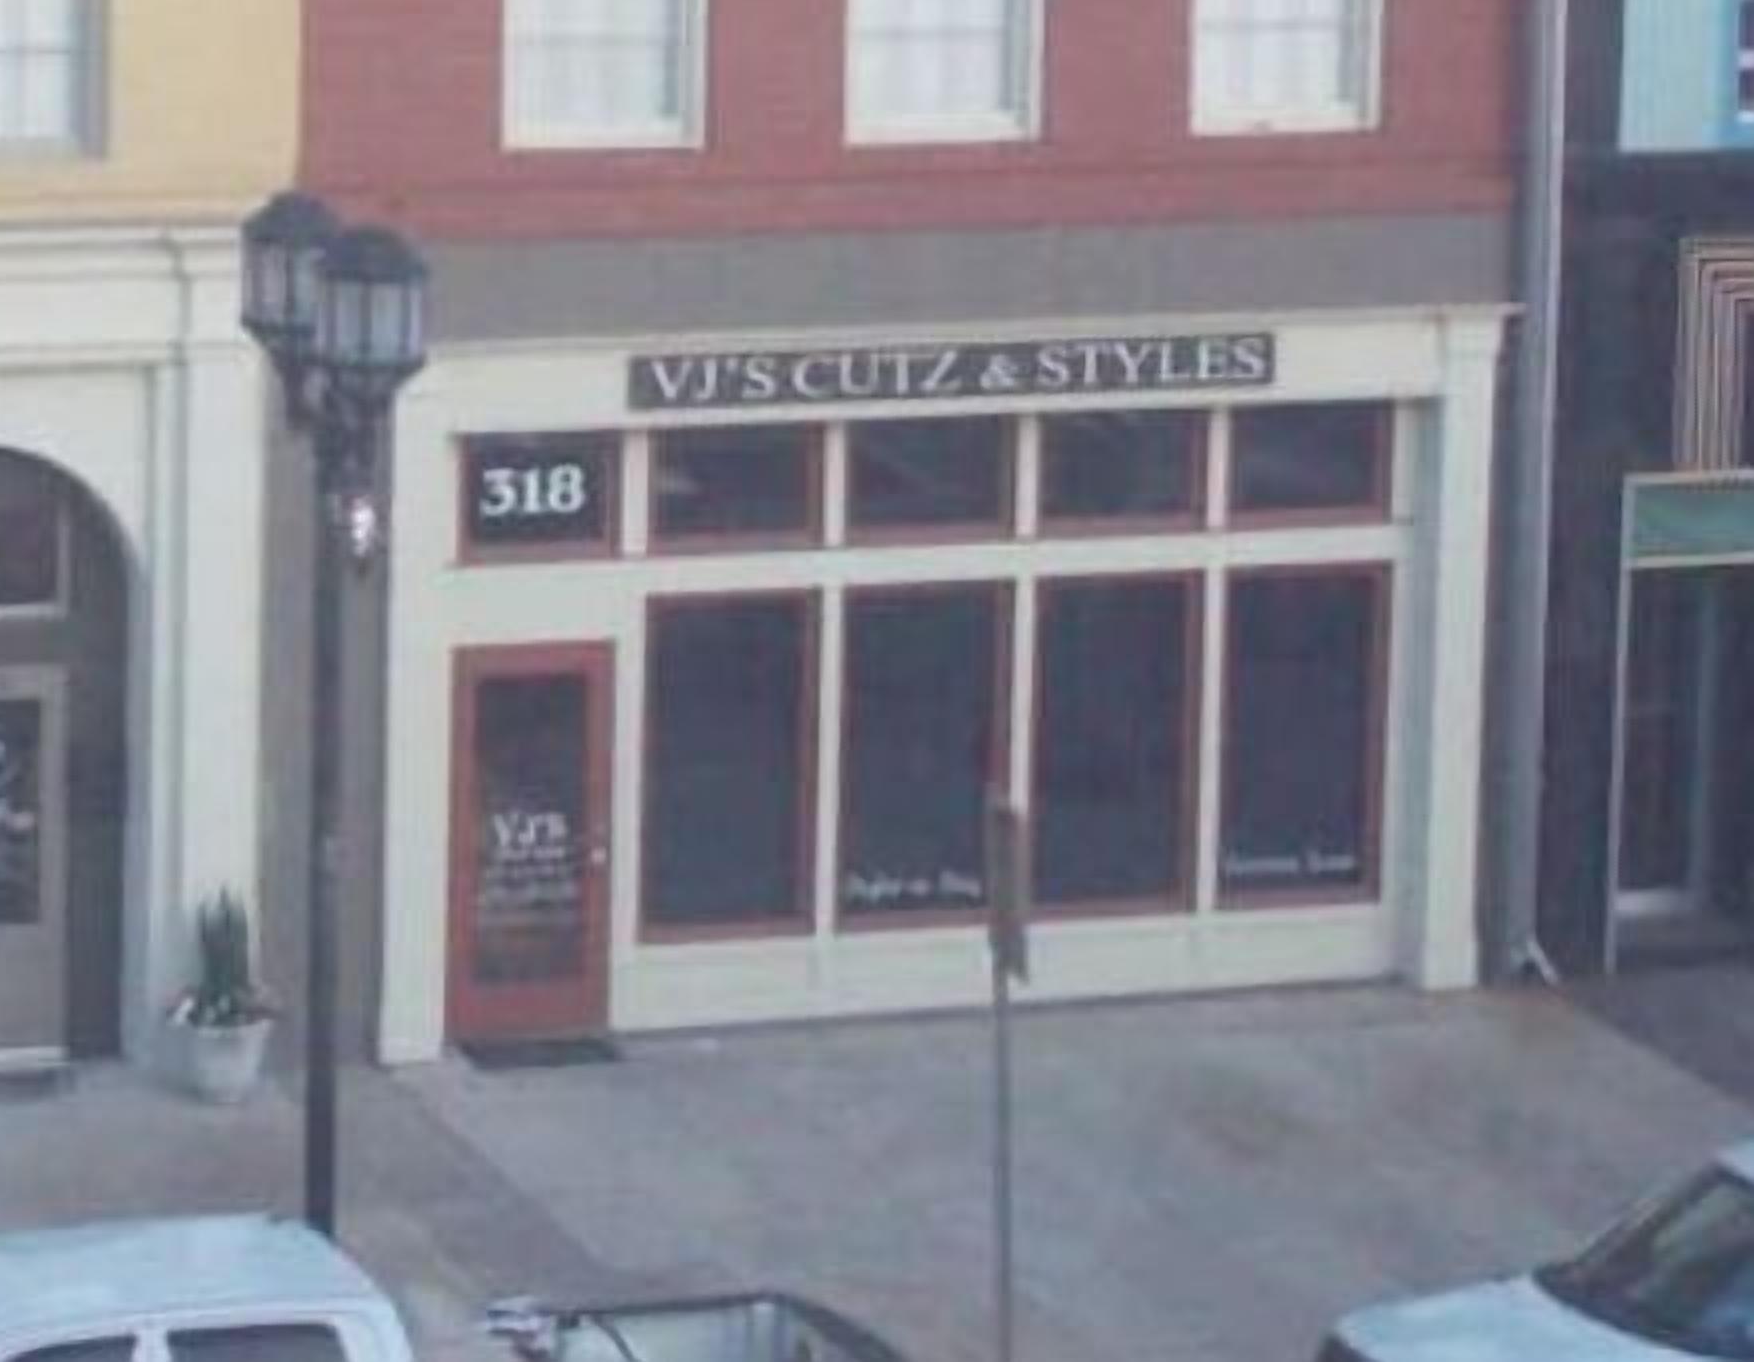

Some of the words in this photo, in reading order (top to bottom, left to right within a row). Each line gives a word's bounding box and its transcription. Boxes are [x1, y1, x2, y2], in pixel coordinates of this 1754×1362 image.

[651, 355, 777, 401] VJ'S
[792, 349, 960, 396] CUTZ
[979, 352, 1019, 389] &
[1035, 336, 1267, 386] STYLES
[480, 463, 586, 518] 318
